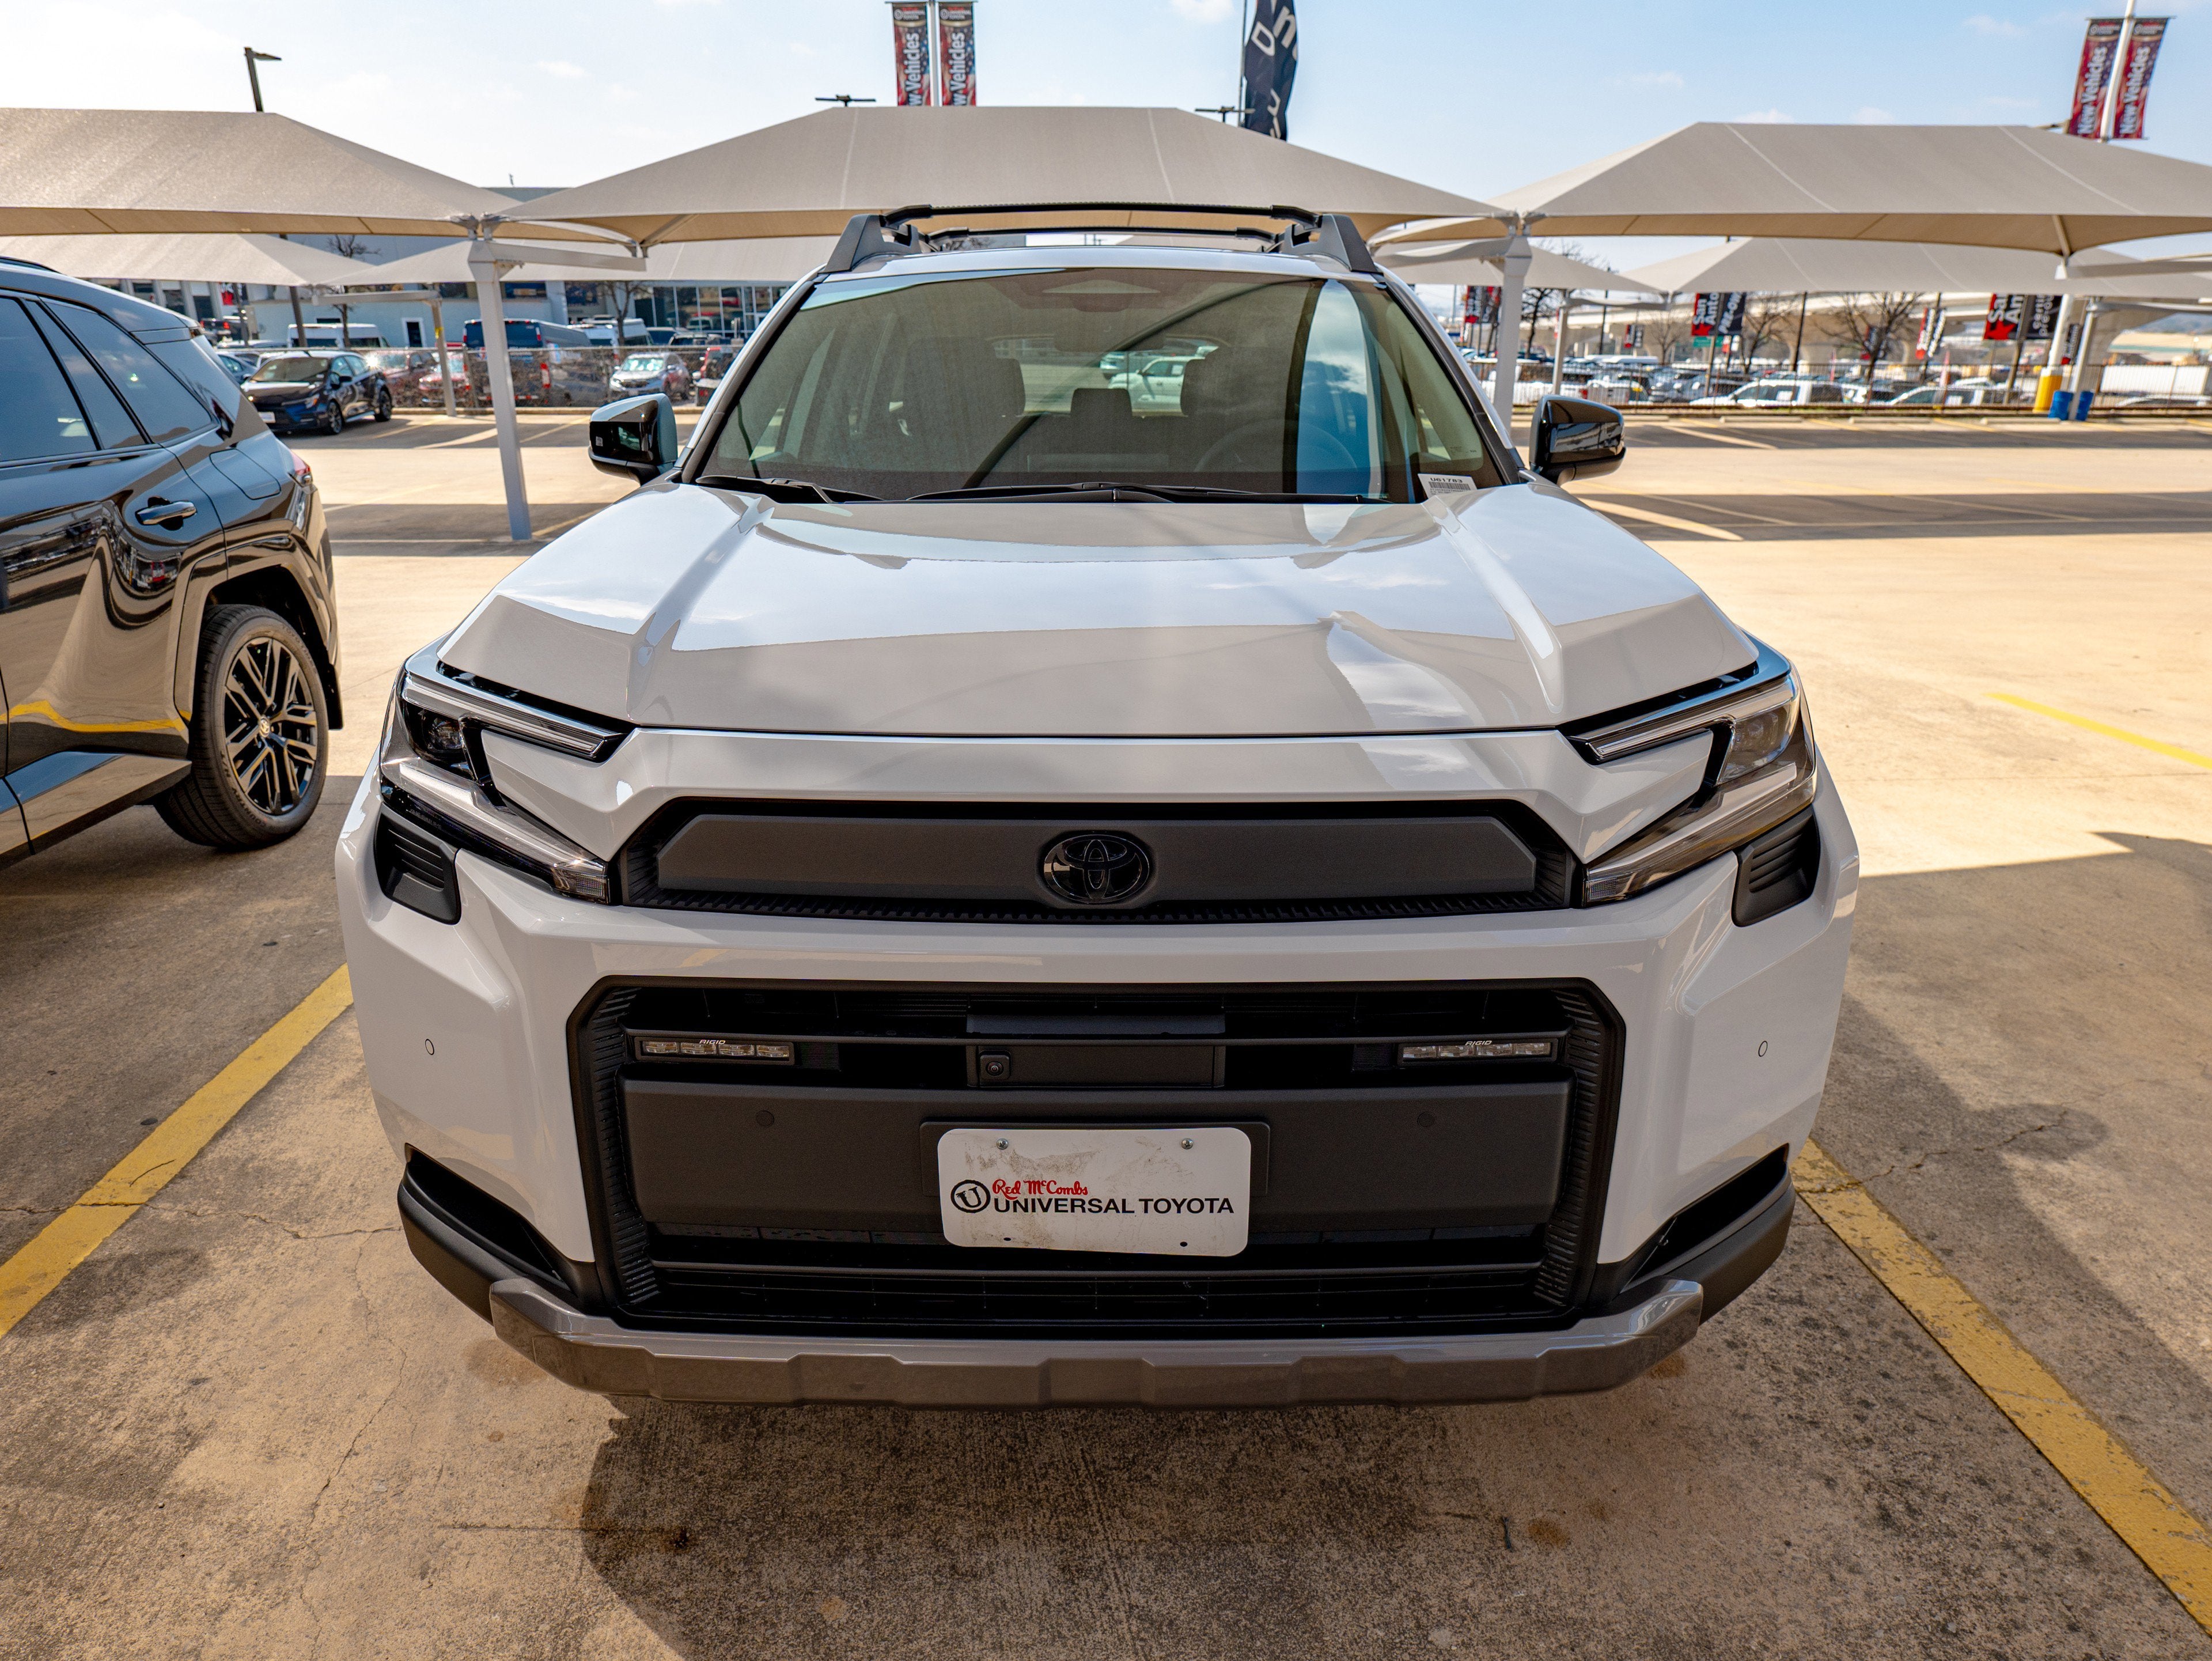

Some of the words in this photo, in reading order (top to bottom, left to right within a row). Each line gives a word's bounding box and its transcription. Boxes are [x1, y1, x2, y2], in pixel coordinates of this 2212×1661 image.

[903, 32, 922, 92] Vehicles
[948, 32, 967, 92] Vehicles
[1692, 298, 1707, 324] San
[992, 1179, 1021, 1200] Red
[1024, 1180, 1088, 1195] McCombs
[994, 1198, 1135, 1213] UNIVERSAL
[1139, 1198, 1234, 1214] TOYOTA
